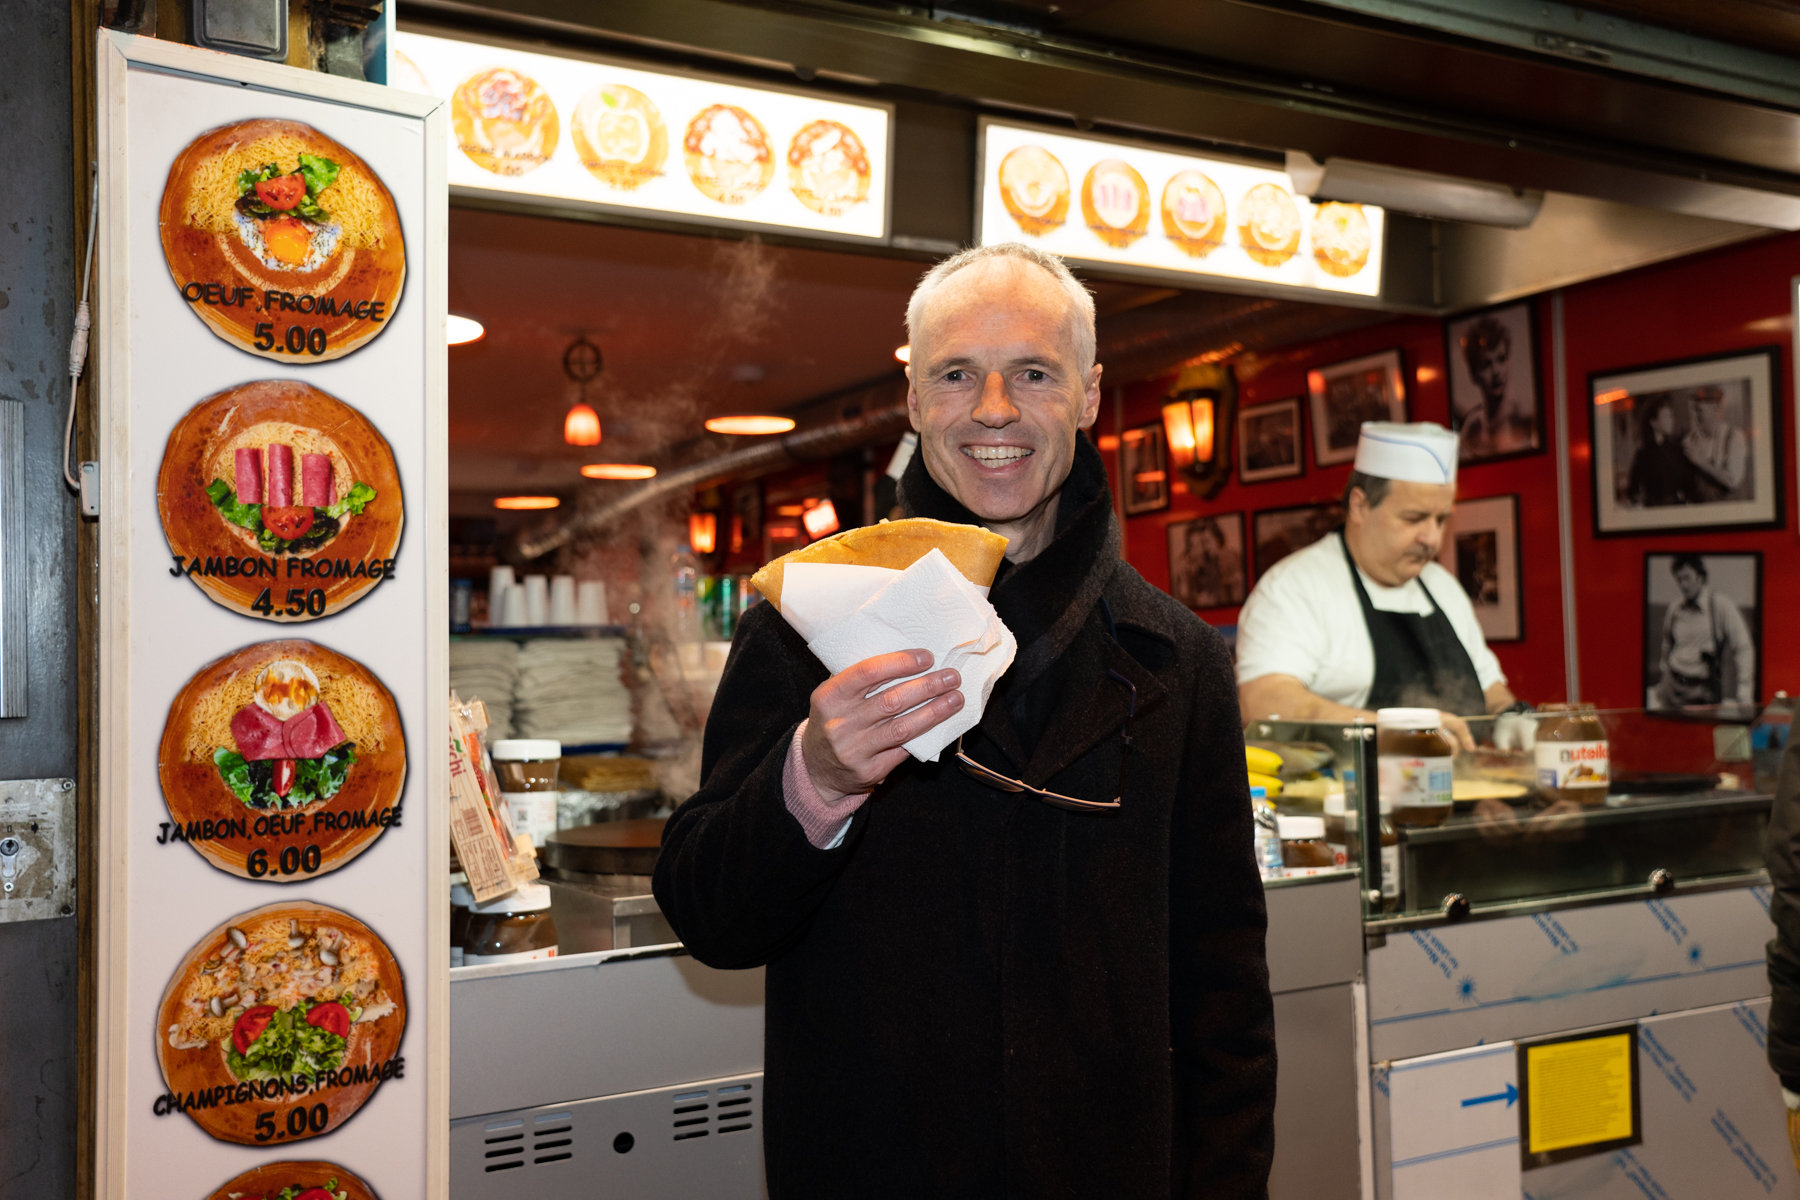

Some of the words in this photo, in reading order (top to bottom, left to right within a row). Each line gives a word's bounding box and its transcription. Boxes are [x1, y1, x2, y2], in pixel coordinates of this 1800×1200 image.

[254, 322, 327, 355] 5.00
[169, 555, 277, 577] JAMBON
[286, 557, 396, 579] FROMAGE
[251, 588, 326, 616] 4.50
[247, 844, 322, 877] 6.00
[254, 1102, 329, 1141] 5.00
